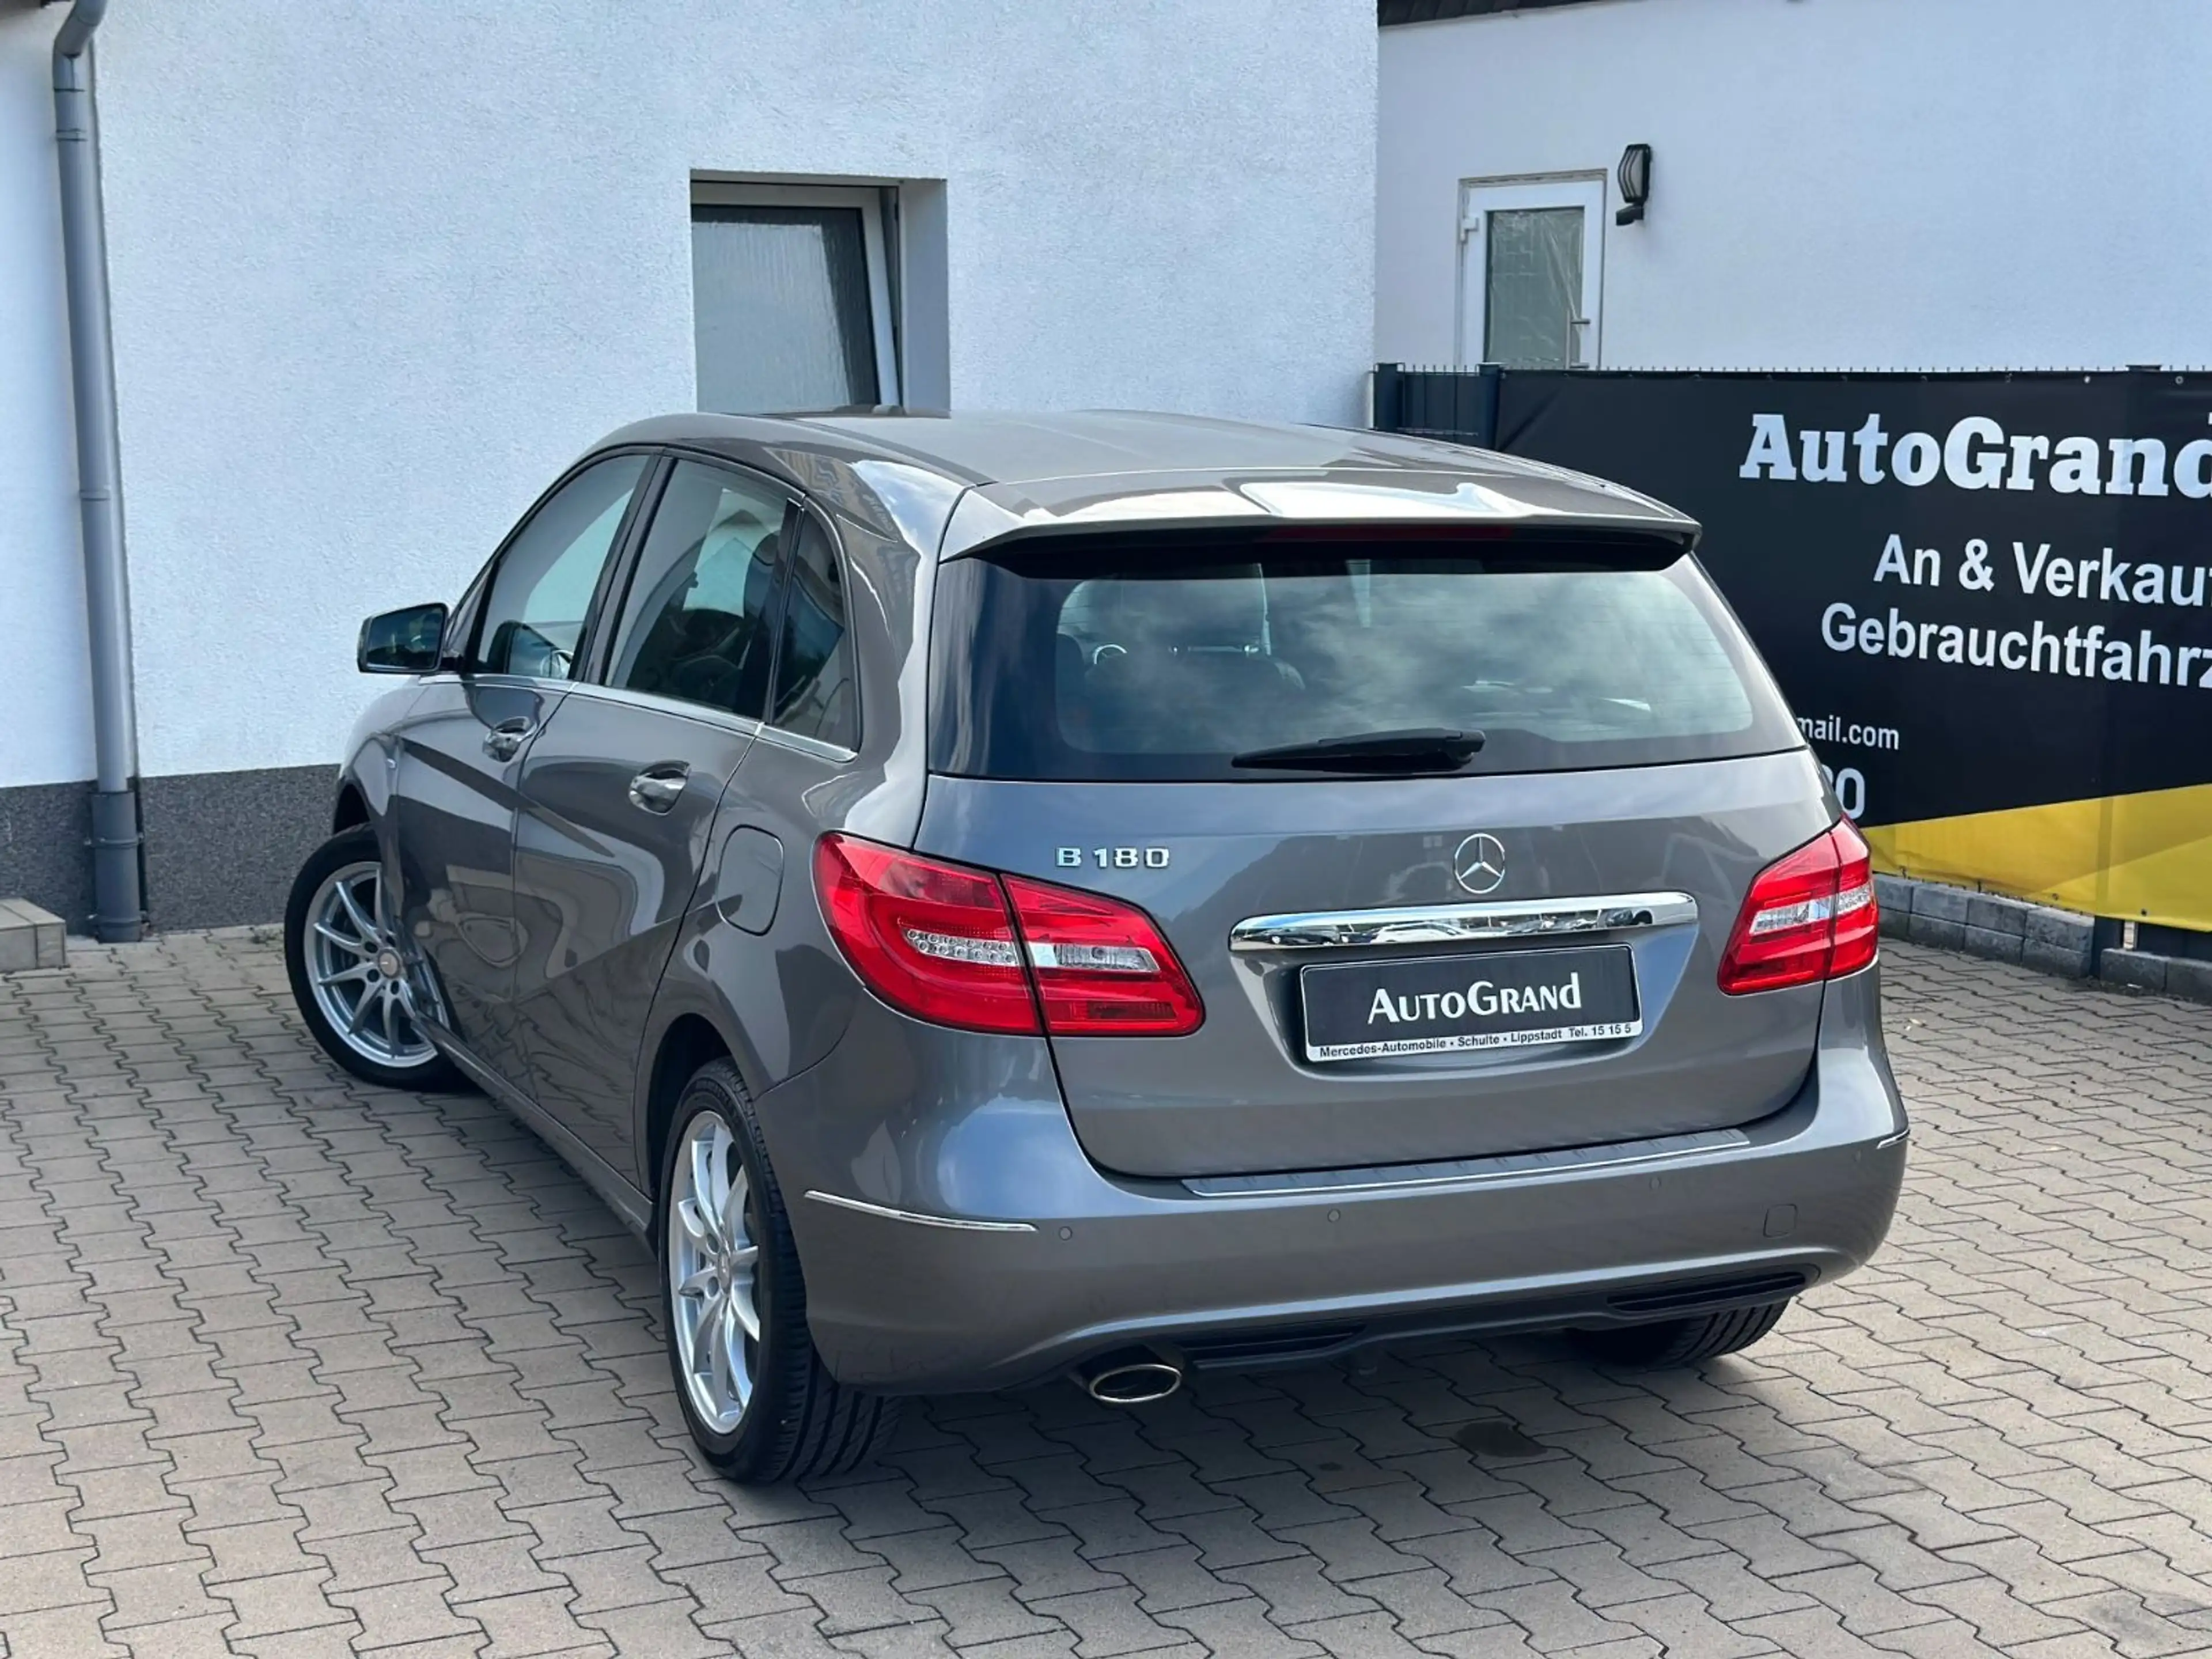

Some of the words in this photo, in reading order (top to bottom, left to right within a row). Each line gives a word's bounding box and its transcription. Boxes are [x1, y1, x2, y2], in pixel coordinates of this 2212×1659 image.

[1873, 533, 1941, 586] An
[1959, 539, 1995, 592] &
[2013, 541, 2212, 606] Verkau
[1821, 764, 1865, 820] 0
[1056, 847, 1082, 868] B
[1092, 847, 1170, 869] 180
[1320, 1037, 1446, 1058] Mercedes-Automobile
[1457, 1032, 1500, 1047] Schulte
[1510, 1029, 1562, 1043] Lippstadt
[1568, 1026, 1588, 1038] Tel.
[1593, 1025, 1605, 1037] 15
[1609, 1023, 1622, 1035] 15
[1624, 1022, 1632, 1035] 5
